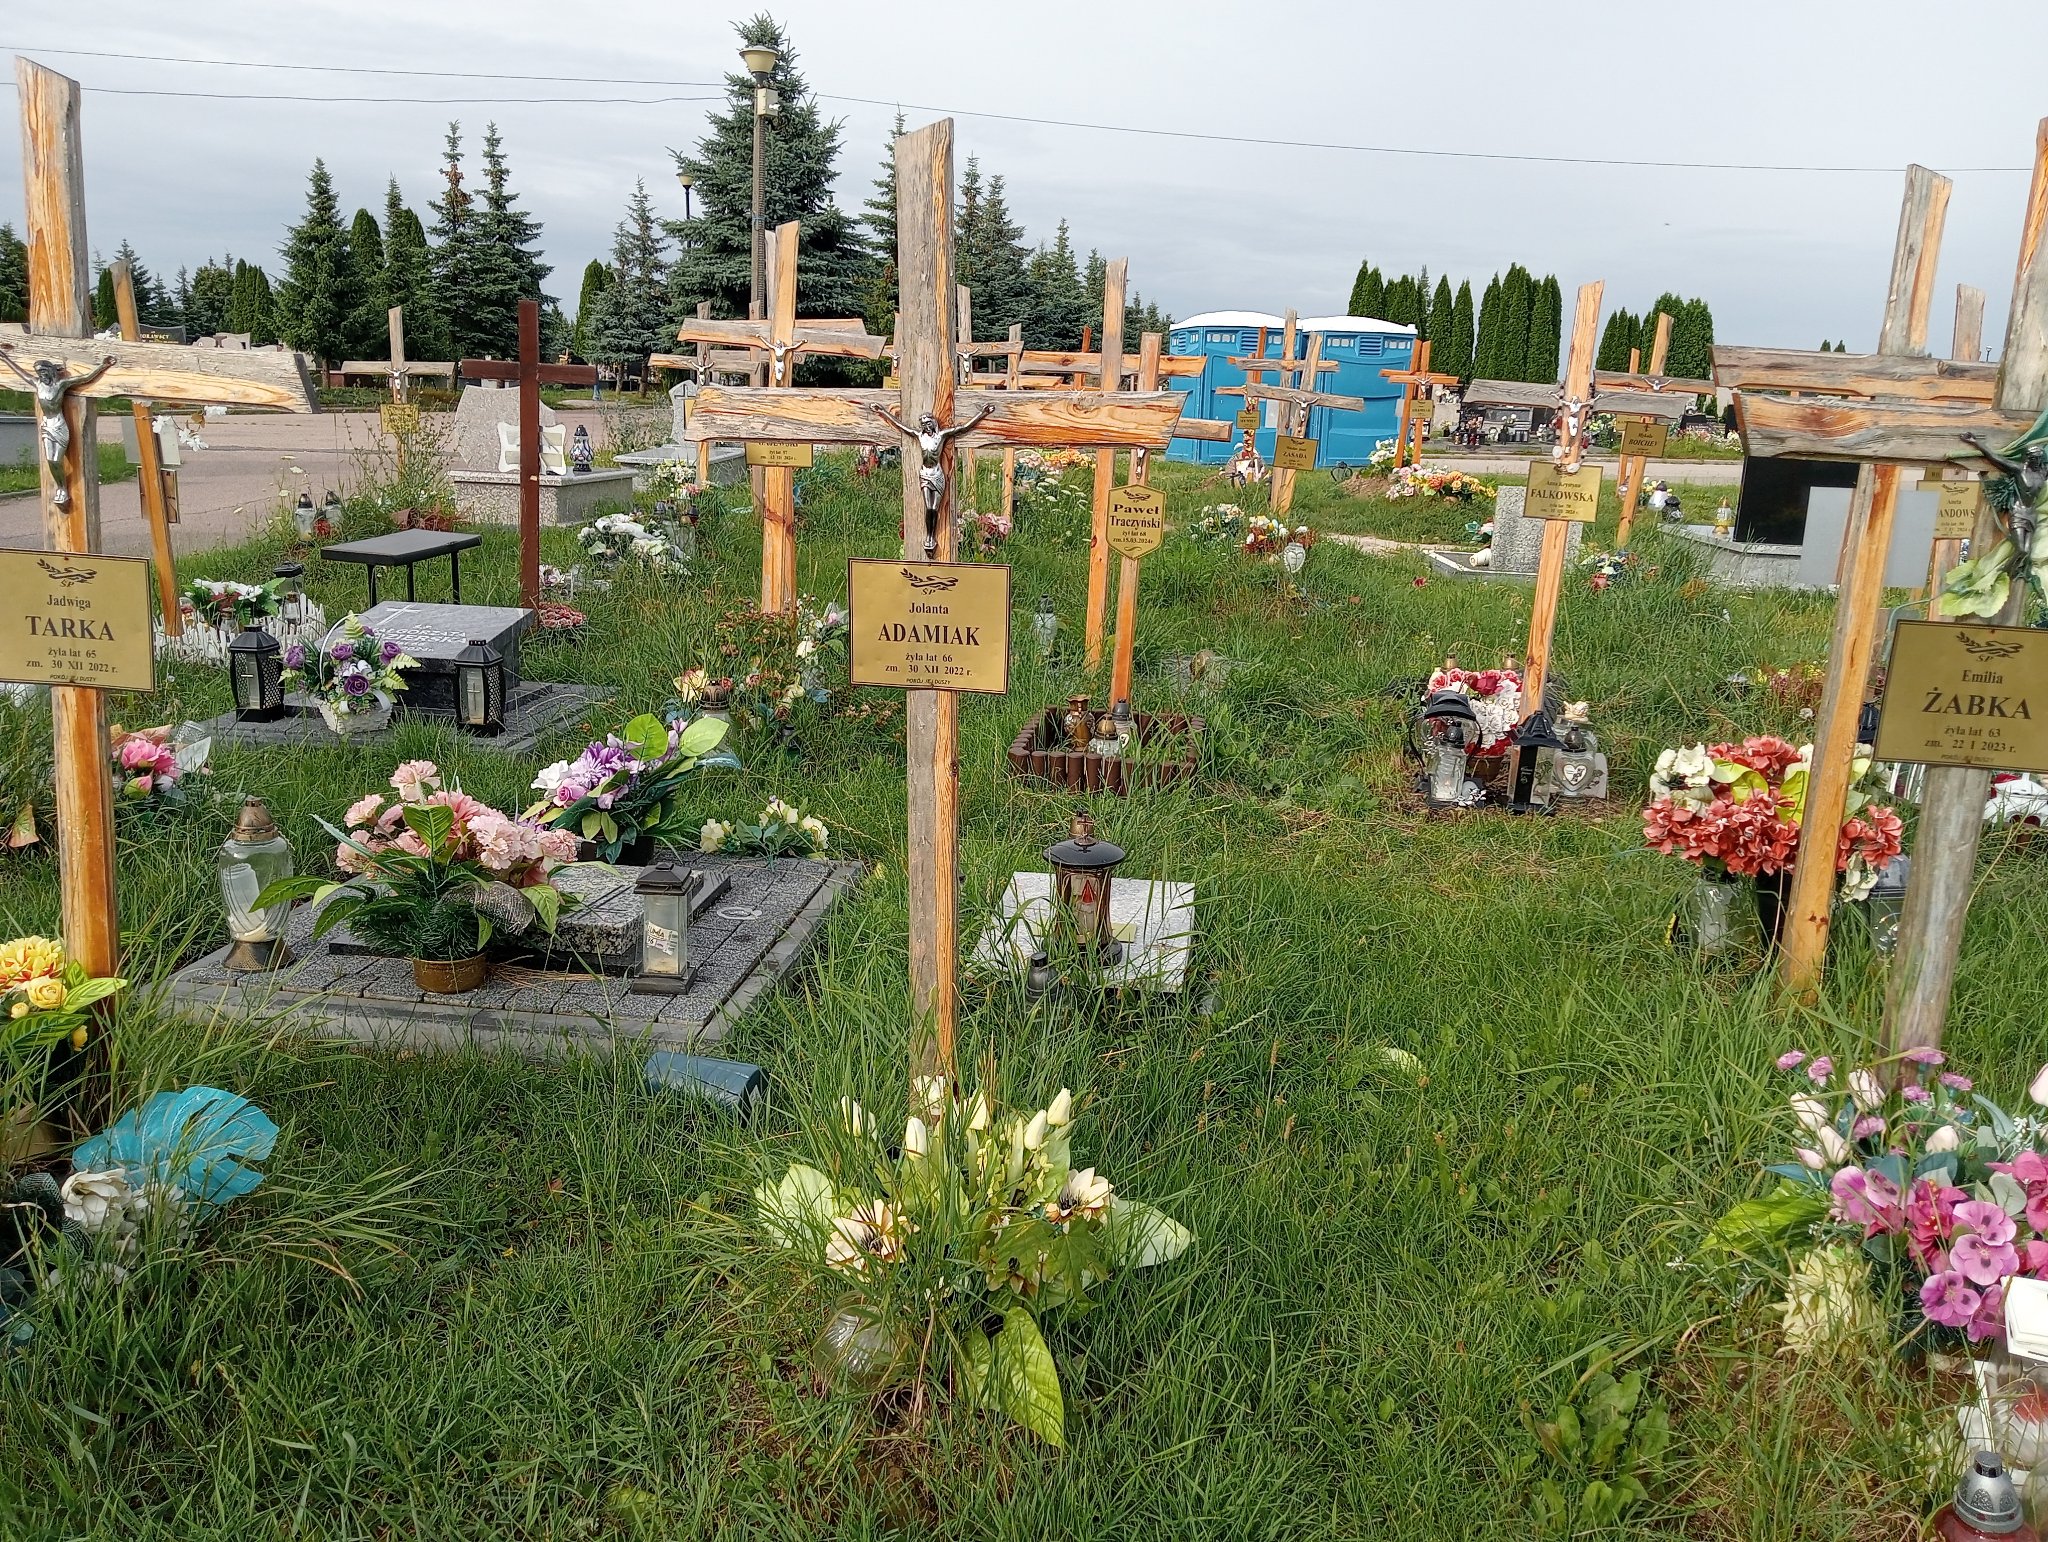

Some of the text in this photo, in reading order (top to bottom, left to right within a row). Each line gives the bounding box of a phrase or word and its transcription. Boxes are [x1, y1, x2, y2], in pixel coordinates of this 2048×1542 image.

[1530, 488, 1594, 502] FALKOWSKA
[1113, 504, 1159, 514] Paweł
[1939, 508, 1976, 518] ANDOWS
[1110, 515, 1160, 530] Traczyński
[47, 595, 90, 611] Jadwiga
[909, 602, 949, 614] Jolanta
[25, 616, 115, 640] TARKA
[878, 623, 980, 646] ADAMIAK
[69, 648, 80, 657] lat
[86, 650, 96, 658] 65
[926, 653, 937, 661] lat
[943, 654, 953, 662] 66
[52, 660, 62, 668] 30
[68, 661, 83, 670] XII
[89, 663, 108, 672] 2022
[908, 665, 918, 673] 30
[924, 665, 939, 673] XII
[945, 667, 964, 675] 2022
[1962, 669, 2003, 684] Emilia
[1922, 687, 2032, 720] ŻABKA
[1969, 727, 1983, 736] lat
[1989, 728, 2000, 737] 63
[1952, 740, 1964, 748] 22
[1971, 741, 1975, 749] I
[1981, 741, 2006, 751] 2023
[2009, 745, 2016, 753] r.
